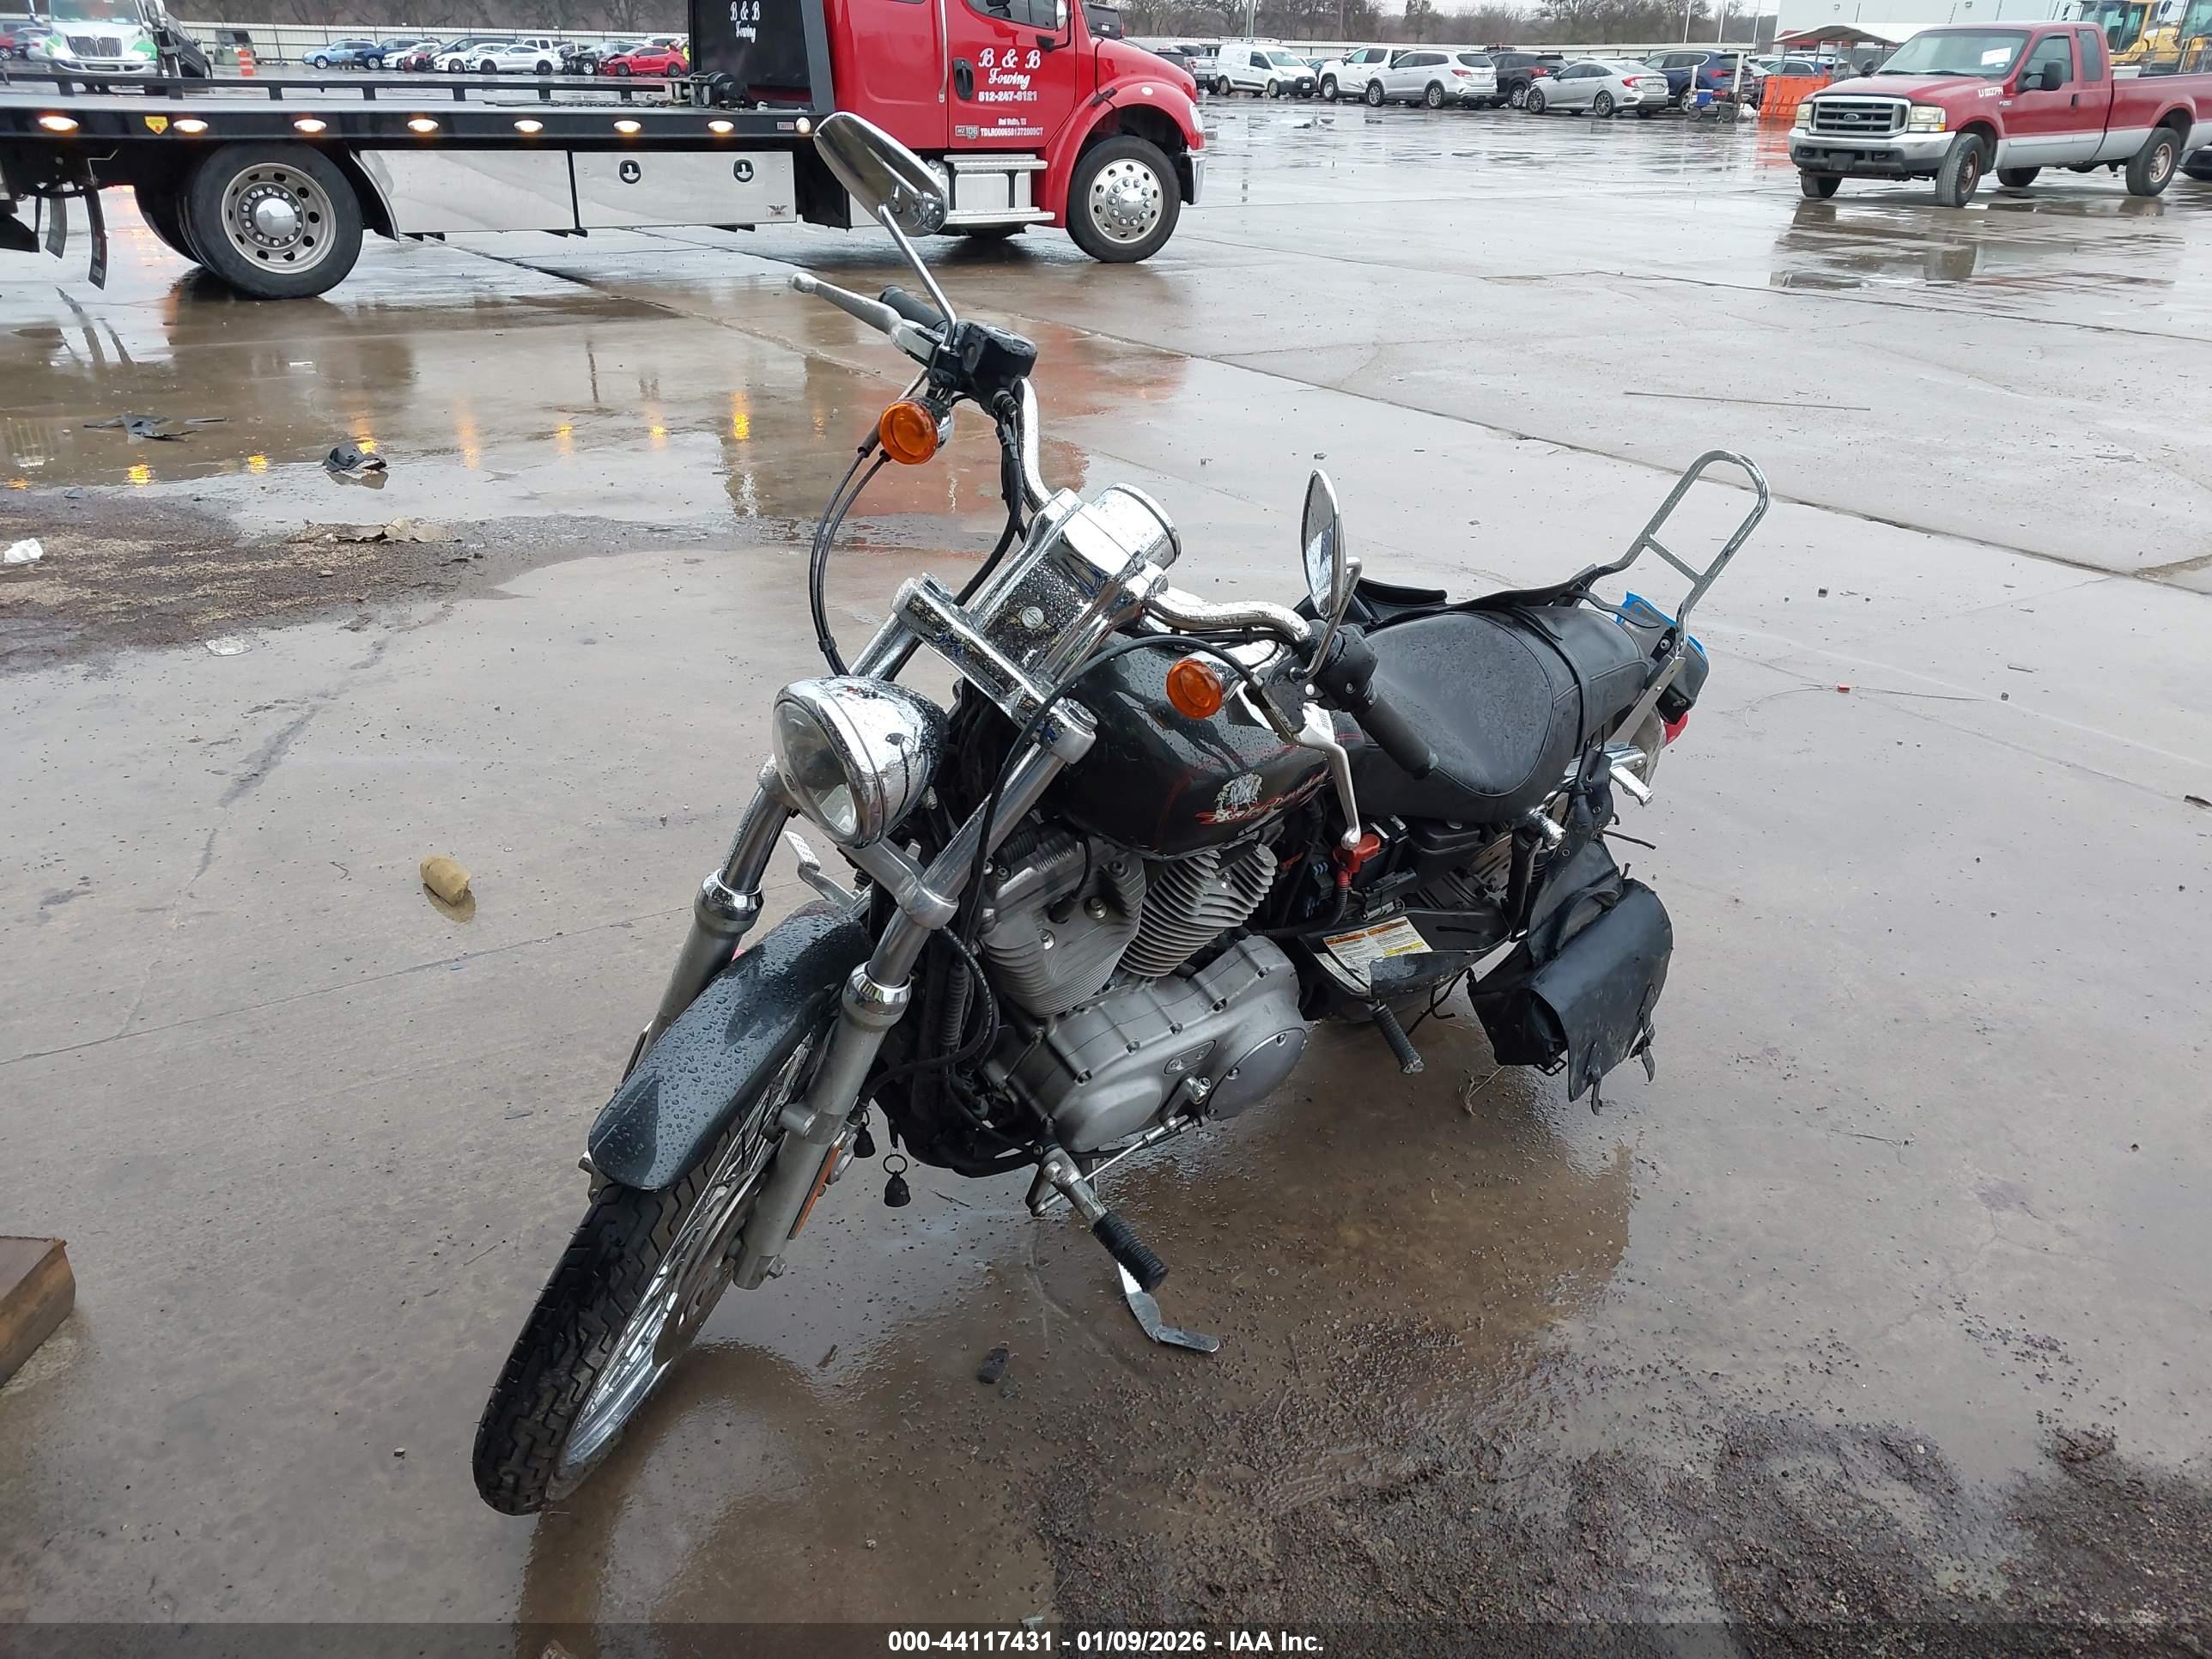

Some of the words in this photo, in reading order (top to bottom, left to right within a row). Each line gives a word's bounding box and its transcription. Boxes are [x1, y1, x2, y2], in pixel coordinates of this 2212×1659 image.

[730, 1, 738, 21] B
[740, 0, 749, 21] &
[751, 0, 760, 21] B
[735, 20, 757, 44] Towing
[977, 47, 994, 68] B
[1001, 48, 1018, 69] &
[1024, 49, 1041, 69] B
[988, 67, 1031, 90] Towing
